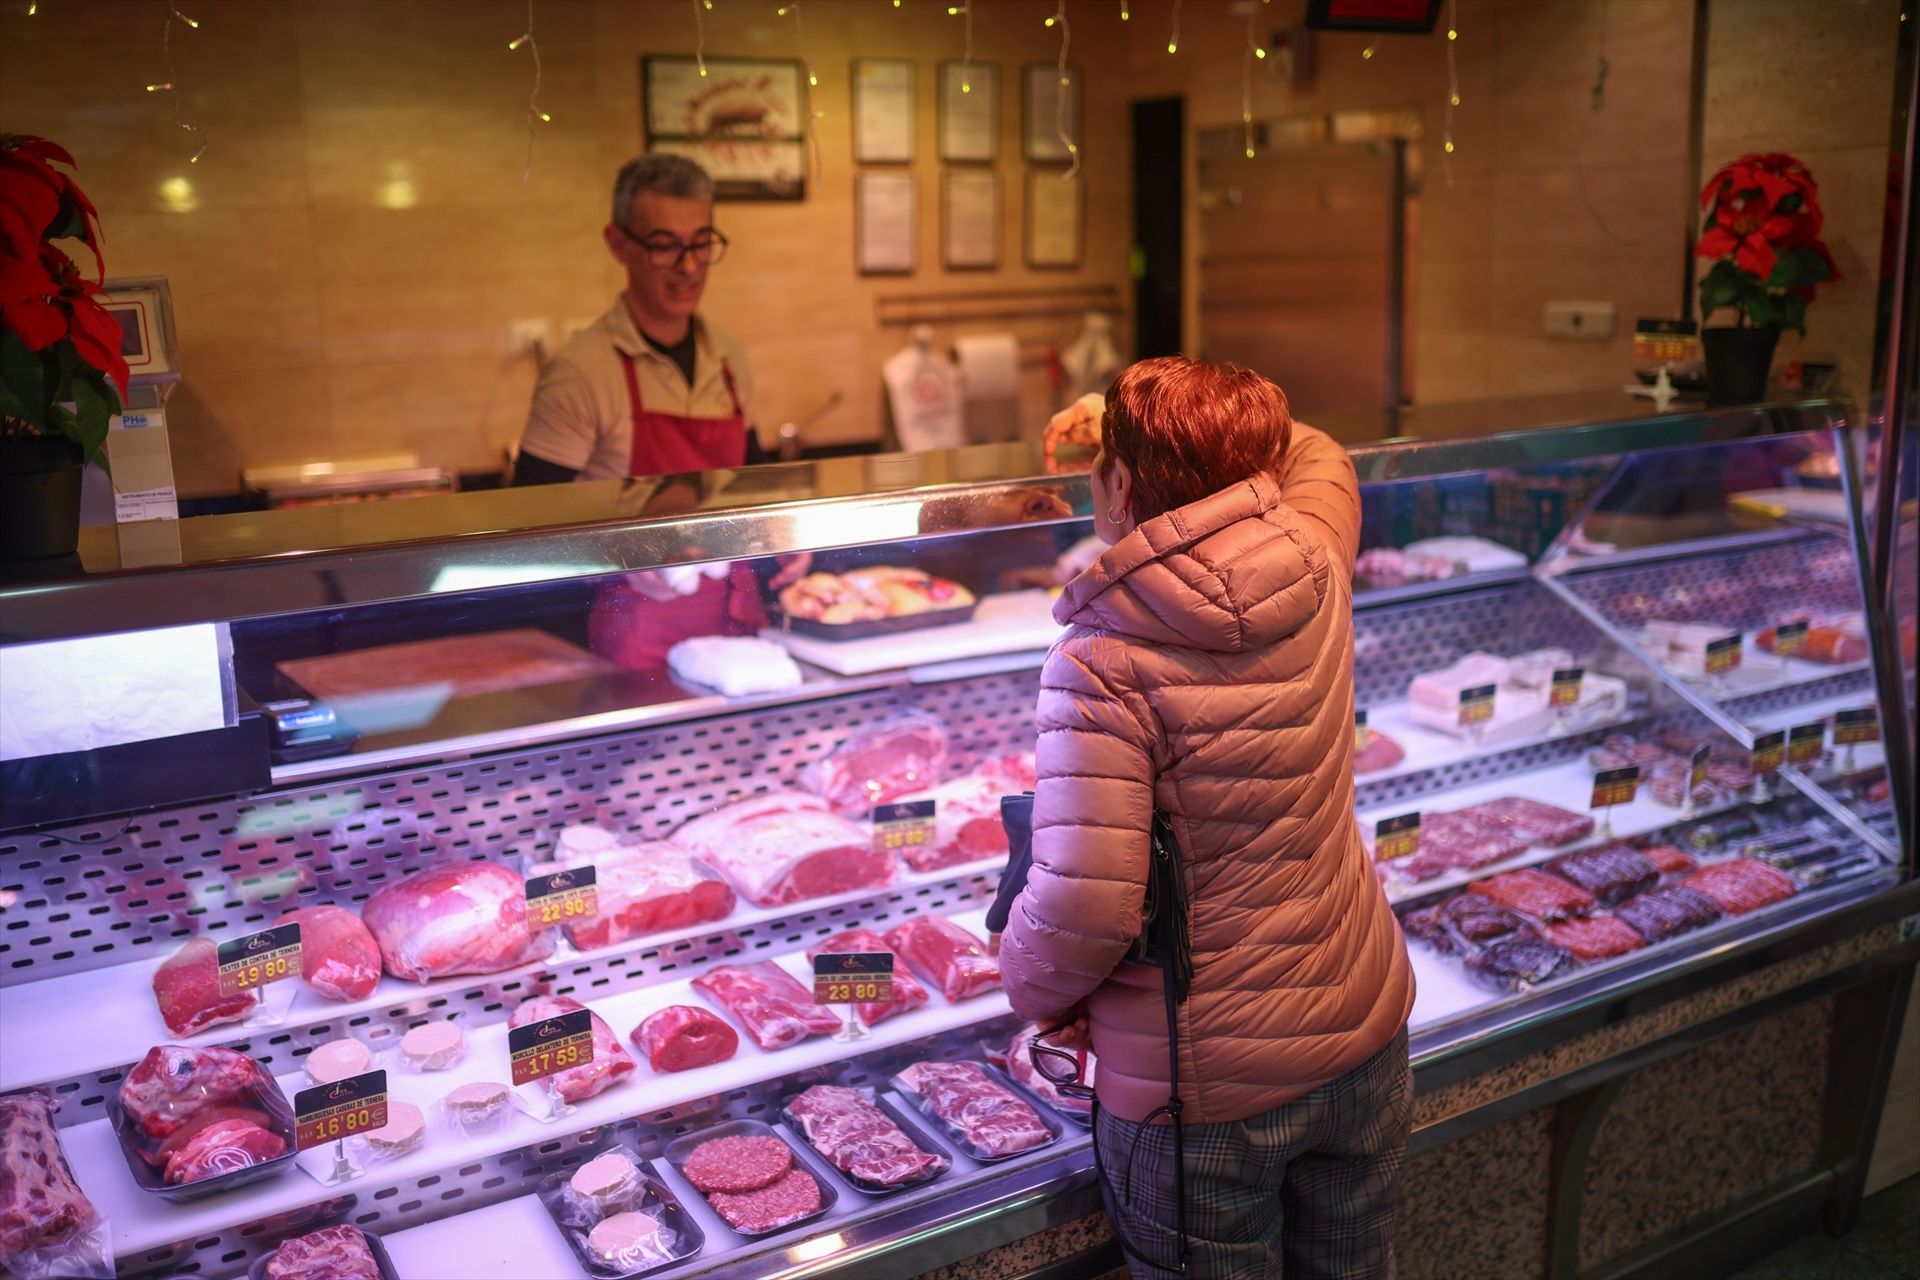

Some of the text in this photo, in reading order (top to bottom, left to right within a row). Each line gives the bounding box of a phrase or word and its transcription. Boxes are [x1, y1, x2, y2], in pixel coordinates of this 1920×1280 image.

[220, 944, 300, 974] FILETES DE CONTRA DE TERNERA
[513, 1032, 591, 1061] MORCILLO DELANTERO DE TERNERA
[529, 1046, 577, 1075] 17'59
[299, 1108, 335, 1123] HAMBURGUESAS
[336, 1101, 356, 1114] CASERAS
[364, 1094, 384, 1105] TERNERA
[316, 1109, 369, 1140] 16'80
